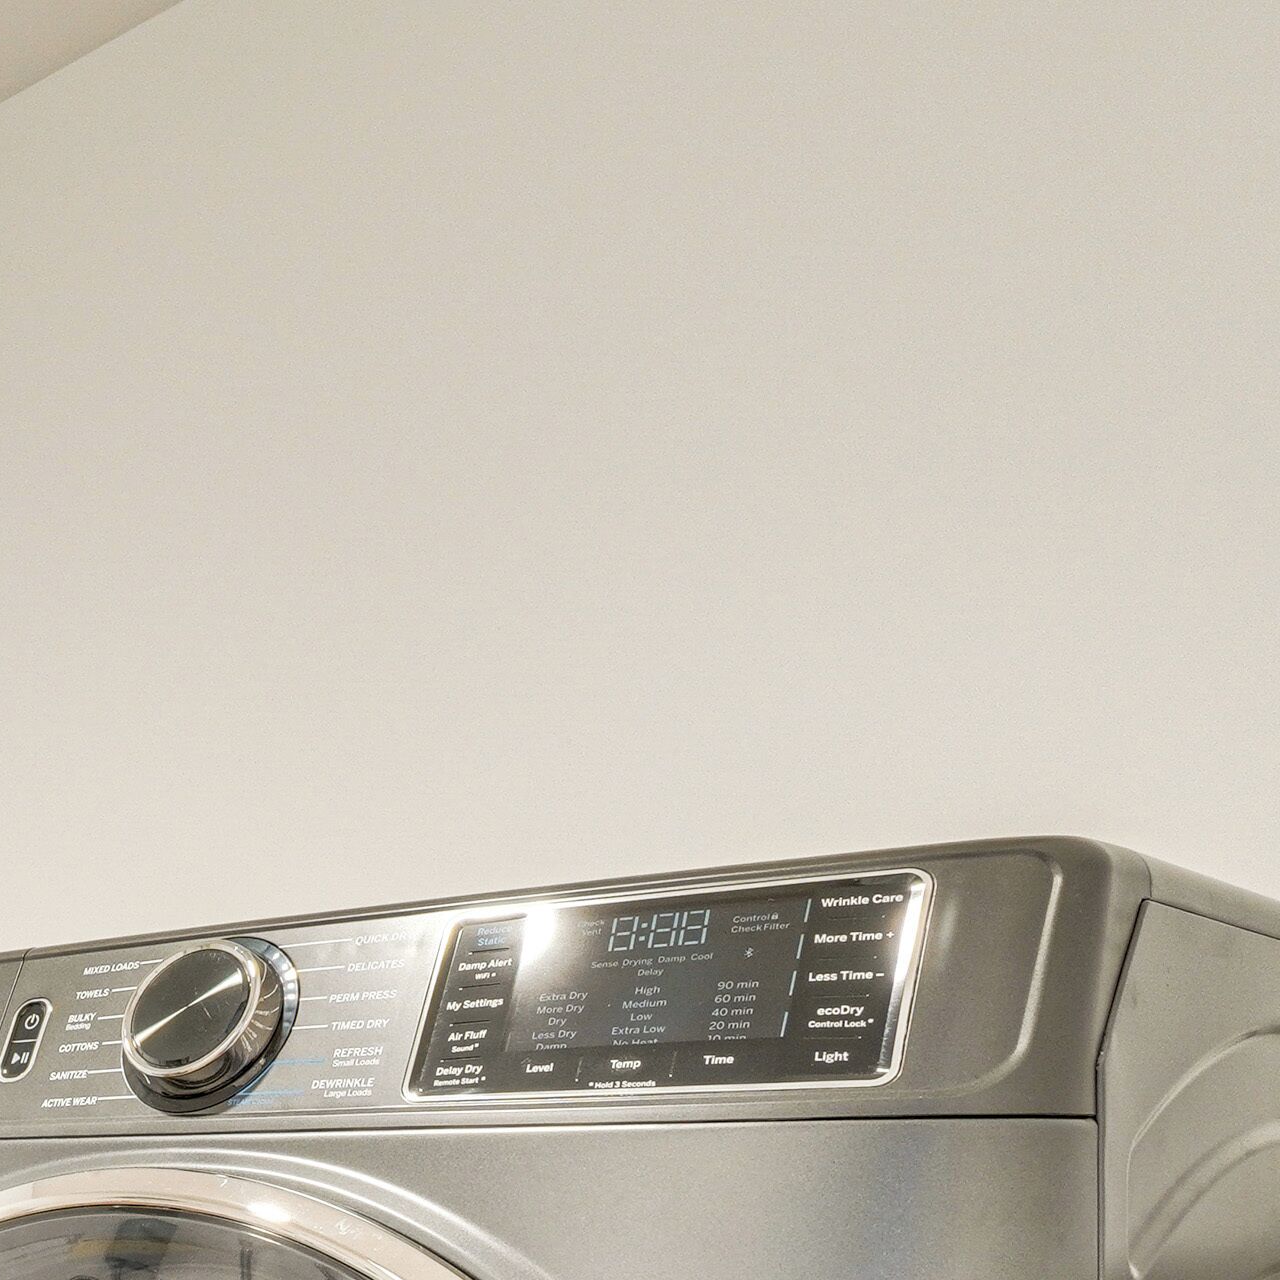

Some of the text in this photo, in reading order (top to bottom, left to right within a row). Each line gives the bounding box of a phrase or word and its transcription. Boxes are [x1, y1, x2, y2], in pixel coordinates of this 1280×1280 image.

[821, 893, 904, 908] Wrinkle Care
[733, 914, 771, 924] Control
[731, 921, 790, 934] Check Filter
[355, 933, 390, 946] QUICK
[477, 937, 506, 946] Static
[814, 934, 848, 944] More
[850, 932, 883, 942] Time
[347, 959, 406, 973] DELICATES
[458, 958, 513, 971] Damp Alert
[591, 952, 714, 969] Sense Drying Damp Cool
[83, 960, 140, 976] MIXED LOADS
[637, 968, 665, 977] Delay
[808, 971, 838, 982] Less
[840, 970, 874, 980] Time
[717, 979, 759, 990] 90 min
[75, 988, 110, 999] TOWELS
[329, 989, 398, 1003] PERM PRESS
[539, 990, 588, 1002] Extra Dry
[635, 986, 661, 996] High
[622, 999, 667, 1009] Medium
[714, 993, 757, 1004] 60 min
[446, 998, 504, 1012] My Settings
[536, 1003, 585, 1015] More Dry
[817, 1005, 864, 1017] ecoDry
[630, 1012, 653, 1021] Low
[711, 1006, 754, 1017] 40 min
[68, 1013, 97, 1024] BULKY
[331, 1018, 390, 1031] TIMED DRY
[548, 1017, 567, 1028] Dry
[808, 1019, 867, 1028] Control Lock
[611, 1024, 666, 1036] Extra Low
[709, 1020, 750, 1031] 20 min
[448, 1029, 488, 1042] Air Fluff
[531, 1029, 577, 1040] Less Dry
[58, 1041, 99, 1053] COTTONS
[333, 1046, 383, 1058] REFRESH
[331, 1057, 381, 1068] Small Loads
[703, 1055, 735, 1066] Time
[814, 1051, 849, 1063] Light
[436, 1064, 483, 1076] Delay Dry
[526, 1062, 554, 1073] Level
[610, 1059, 641, 1071] Temp
[49, 1069, 89, 1081] SANITIZE
[311, 1077, 375, 1090] DEWRINKLE
[433, 1076, 479, 1087] Remote Start
[594, 1079, 656, 1089] Hold 3 Seconds
[324, 1088, 372, 1099] Large Loads
[41, 1095, 98, 1109] ACTIVE WEAR
